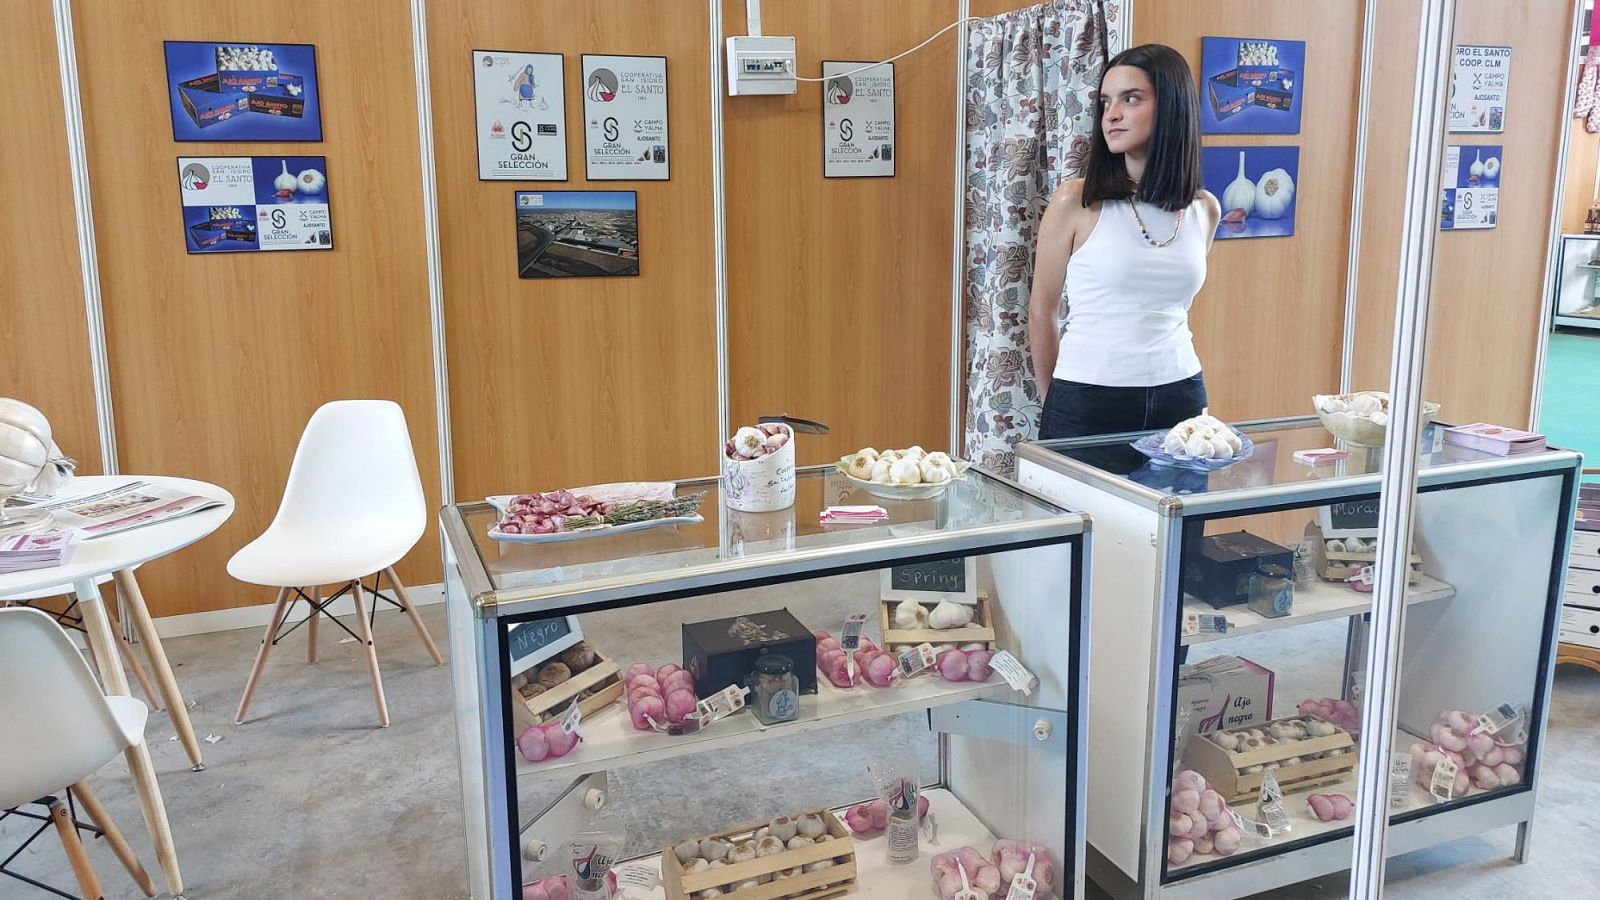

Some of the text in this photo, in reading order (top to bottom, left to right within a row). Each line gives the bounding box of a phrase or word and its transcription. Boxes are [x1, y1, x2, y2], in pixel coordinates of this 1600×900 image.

[1484, 49, 1511, 57] SANTO
[621, 85, 664, 95] EL SANTO
[867, 88, 892, 97] SANTO
[593, 147, 631, 156] SELECCIÓN
[510, 153, 536, 161] GRAN
[497, 159, 549, 169] SELECCIÓN
[225, 175, 252, 183] SANTO
[517, 622, 558, 649] Negro
[1228, 713, 1253, 725] negro
